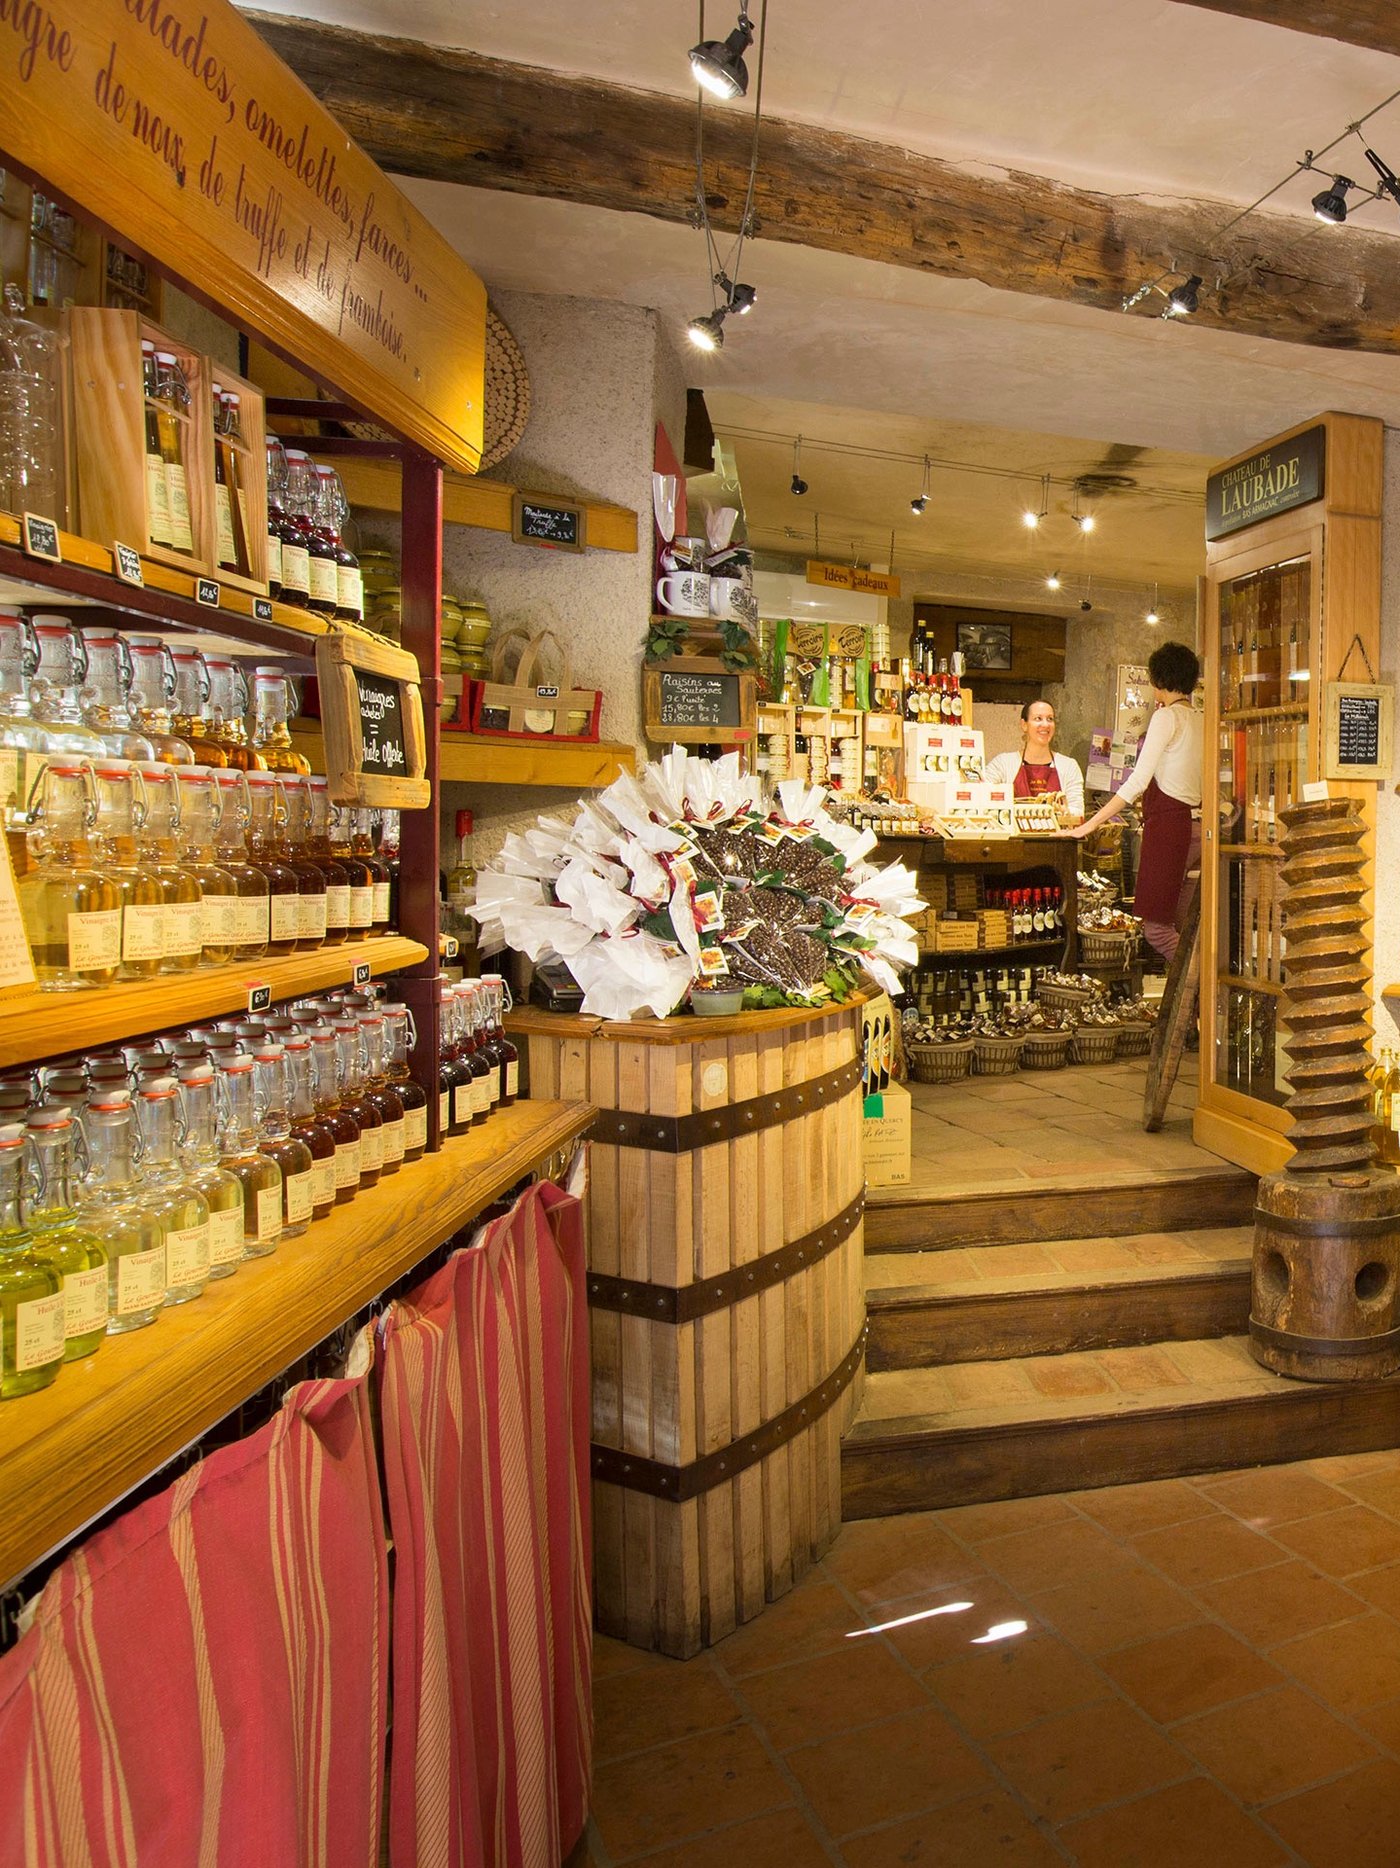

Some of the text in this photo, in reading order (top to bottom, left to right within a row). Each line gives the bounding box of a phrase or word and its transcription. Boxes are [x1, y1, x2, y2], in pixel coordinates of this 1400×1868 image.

[95, 42, 132, 124] de
[200, 135, 226, 207] de
[235, 163, 287, 279] truffe
[294, 225, 314, 280] et
[245, 98, 355, 241] omelettes,
[1260, 454, 1271, 472] DE
[1222, 457, 1300, 517] LAUBADE
[824, 567, 889, 591] Idées cadeaux
[662, 673, 702, 687] Raisins
[712, 704, 720, 713] 2
[712, 714, 719, 724] 4
